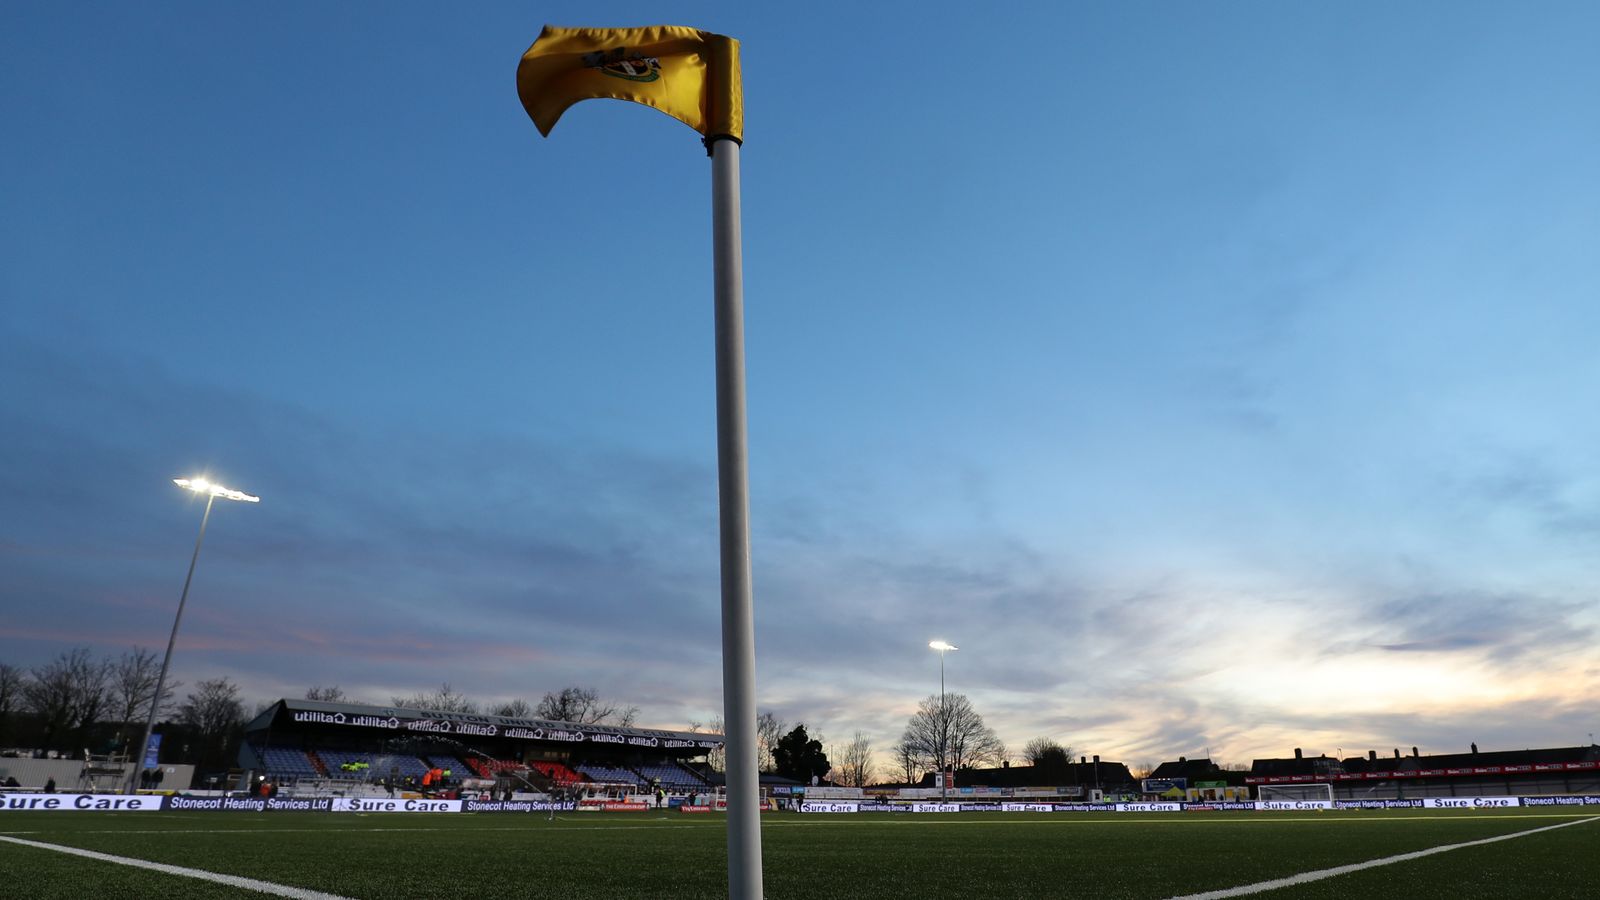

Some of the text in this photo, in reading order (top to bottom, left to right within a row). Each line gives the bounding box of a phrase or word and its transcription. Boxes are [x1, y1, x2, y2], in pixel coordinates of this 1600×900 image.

[295, 712, 334, 722] utilita
[353, 717, 387, 728] utilita
[408, 721, 439, 732] utilita
[421, 712, 488, 722] SUTTON
[500, 719, 555, 728] UNITED
[564, 724, 632, 734] FOOTBALL
[457, 724, 487, 735] utilita
[505, 728, 535, 739] utilita
[548, 731, 576, 741] utilita
[629, 738, 651, 746] utilita
[74, 794, 142, 809] Care
[170, 797, 328, 811] Stonecot Heating Services Ltd
[349, 799, 449, 811] Sure Care
[468, 801, 574, 812] Stonecot Heating Services Ltd
[1435, 798, 1509, 807] Sure Care
[1556, 797, 1583, 805] Heating
